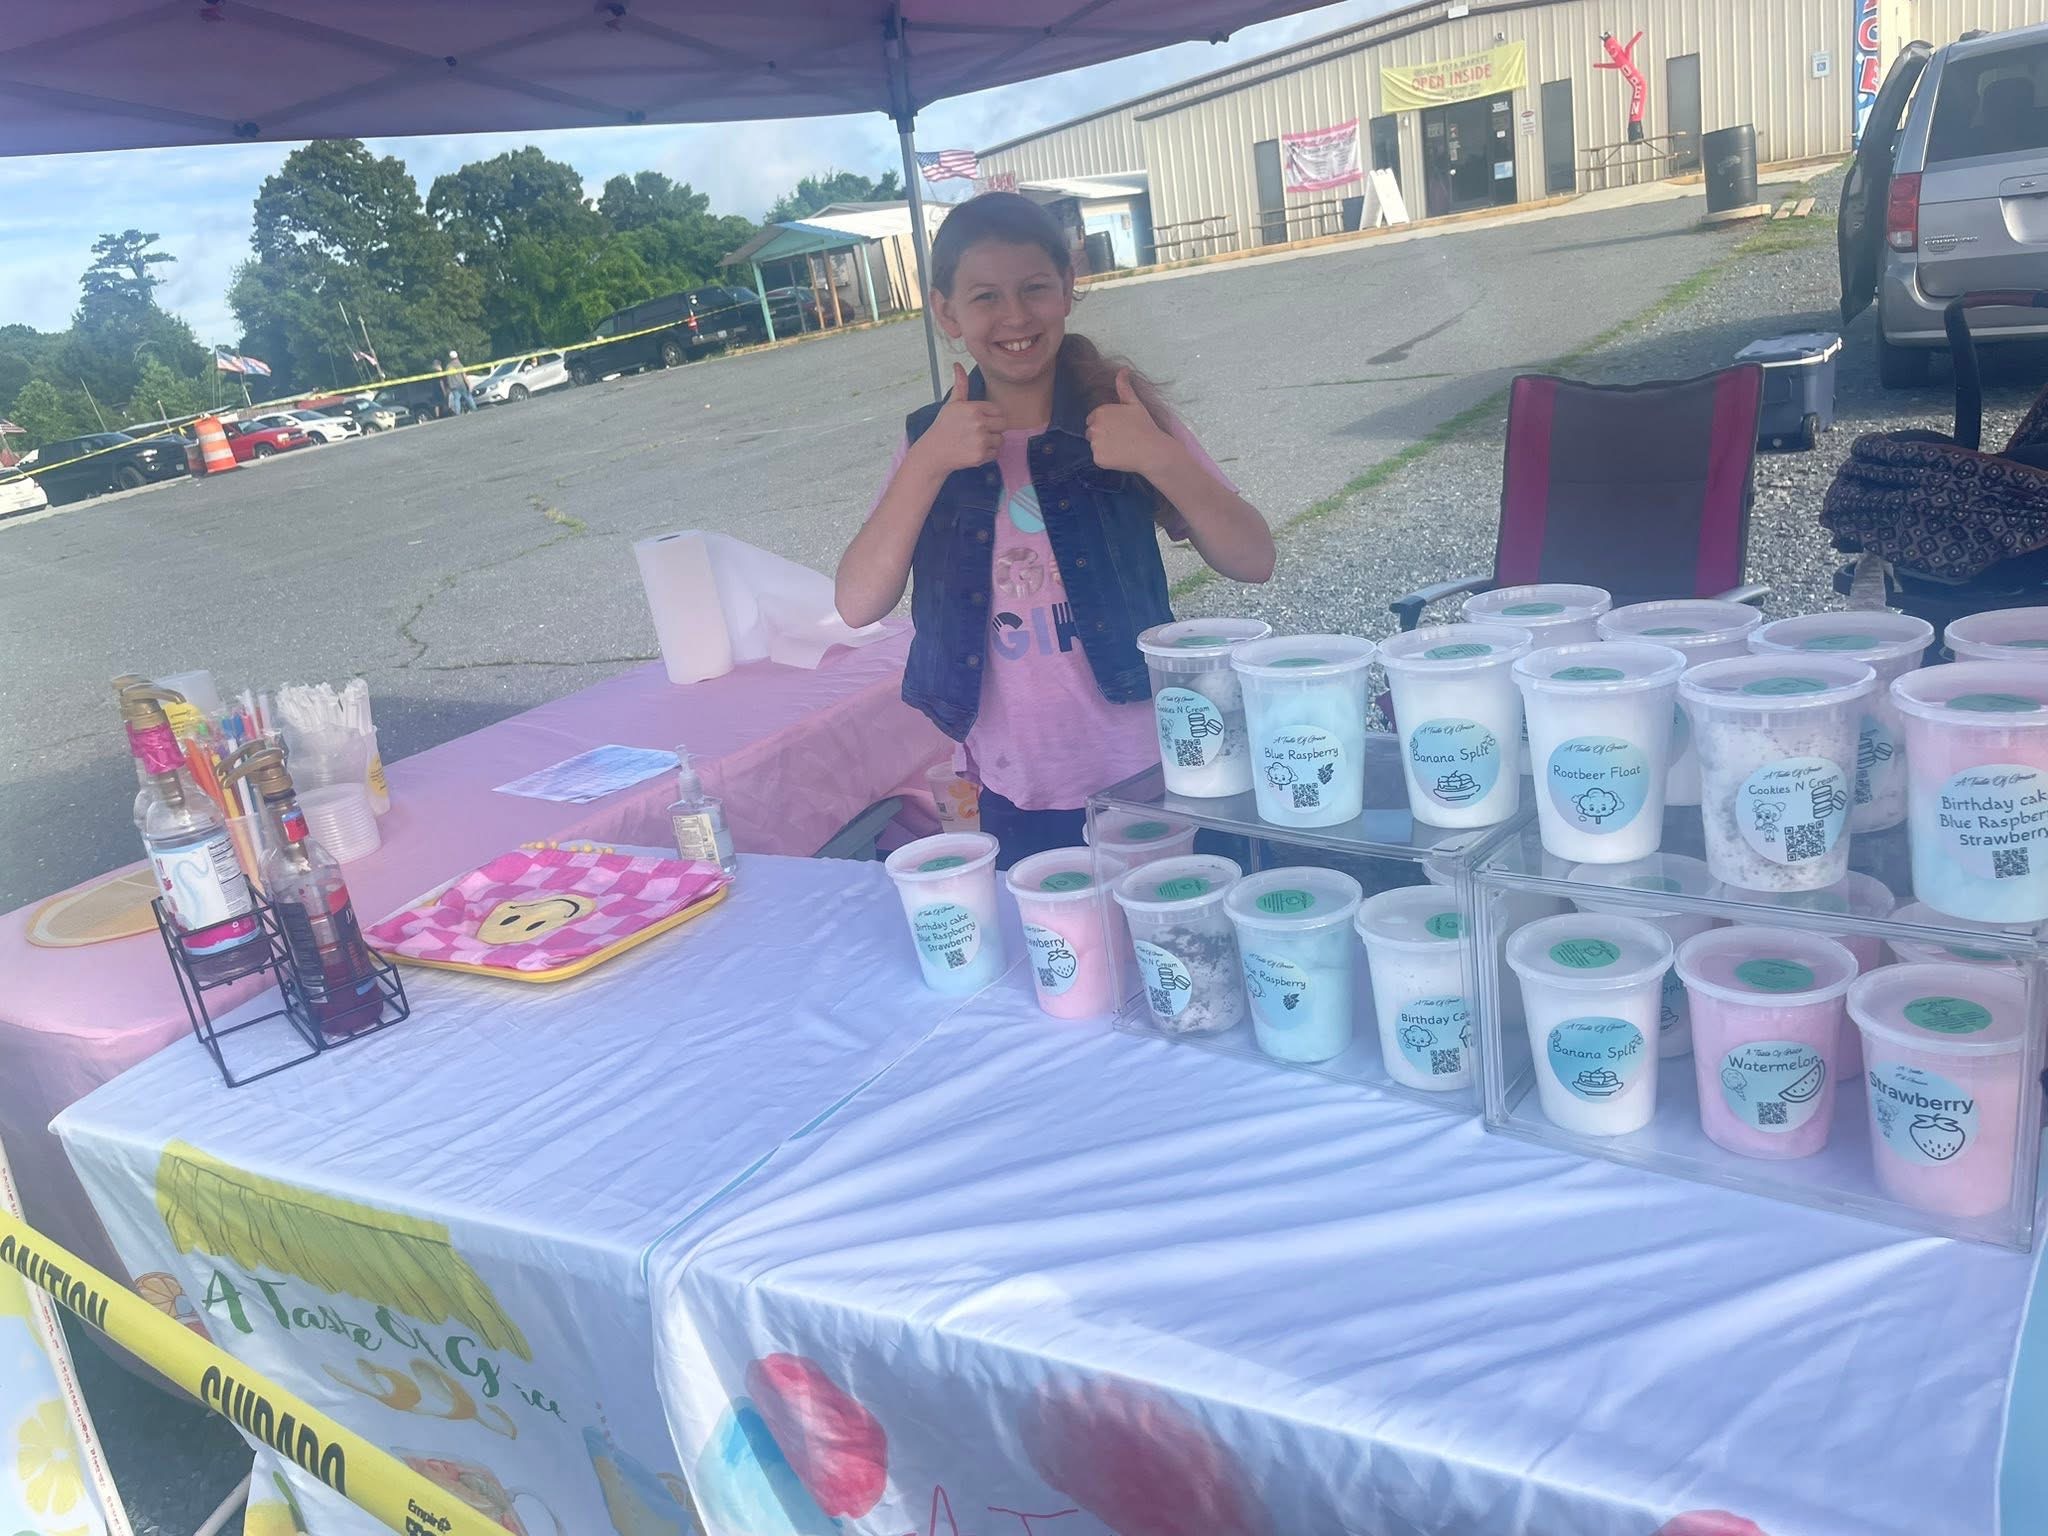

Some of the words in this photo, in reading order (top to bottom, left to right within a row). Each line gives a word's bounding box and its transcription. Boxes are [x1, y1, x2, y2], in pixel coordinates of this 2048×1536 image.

[1412, 74, 1445, 91] OPEN
[1451, 63, 1492, 86] INSIDE
[1186, 706, 1210, 714] Cream
[1264, 747, 1284, 760] Blue
[1288, 747, 1339, 762] Raspberry
[1413, 749, 1455, 763] Banana
[1460, 744, 1490, 763] Split
[1553, 764, 1606, 780] Rootbeer
[1610, 765, 1641, 779] Float
[1748, 784, 1791, 795] Cookies
[1795, 781, 1805, 792] N
[1808, 774, 1839, 789] Cream
[1940, 795, 2014, 814] Birthday
[2020, 788, 2048, 806] cak
[1939, 813, 1972, 829] Blue
[1978, 810, 2048, 831] Raspber
[914, 921, 948, 932] Birthday
[949, 912, 969, 926] cake
[932, 920, 976, 941] Raspberry
[928, 933, 973, 952] Strawberry
[1156, 959, 1179, 968] Cream
[1259, 969, 1306, 990] Raspberry
[1401, 1013, 1450, 1026] Birthday
[1553, 1040, 1601, 1059] Banana
[1607, 1041, 1637, 1061] Split
[1728, 1054, 1819, 1073] Watermelon
[1869, 1071, 1975, 1115] Strawberry
[202, 1269, 254, 1334] A
[243, 1274, 383, 1351] Taste
